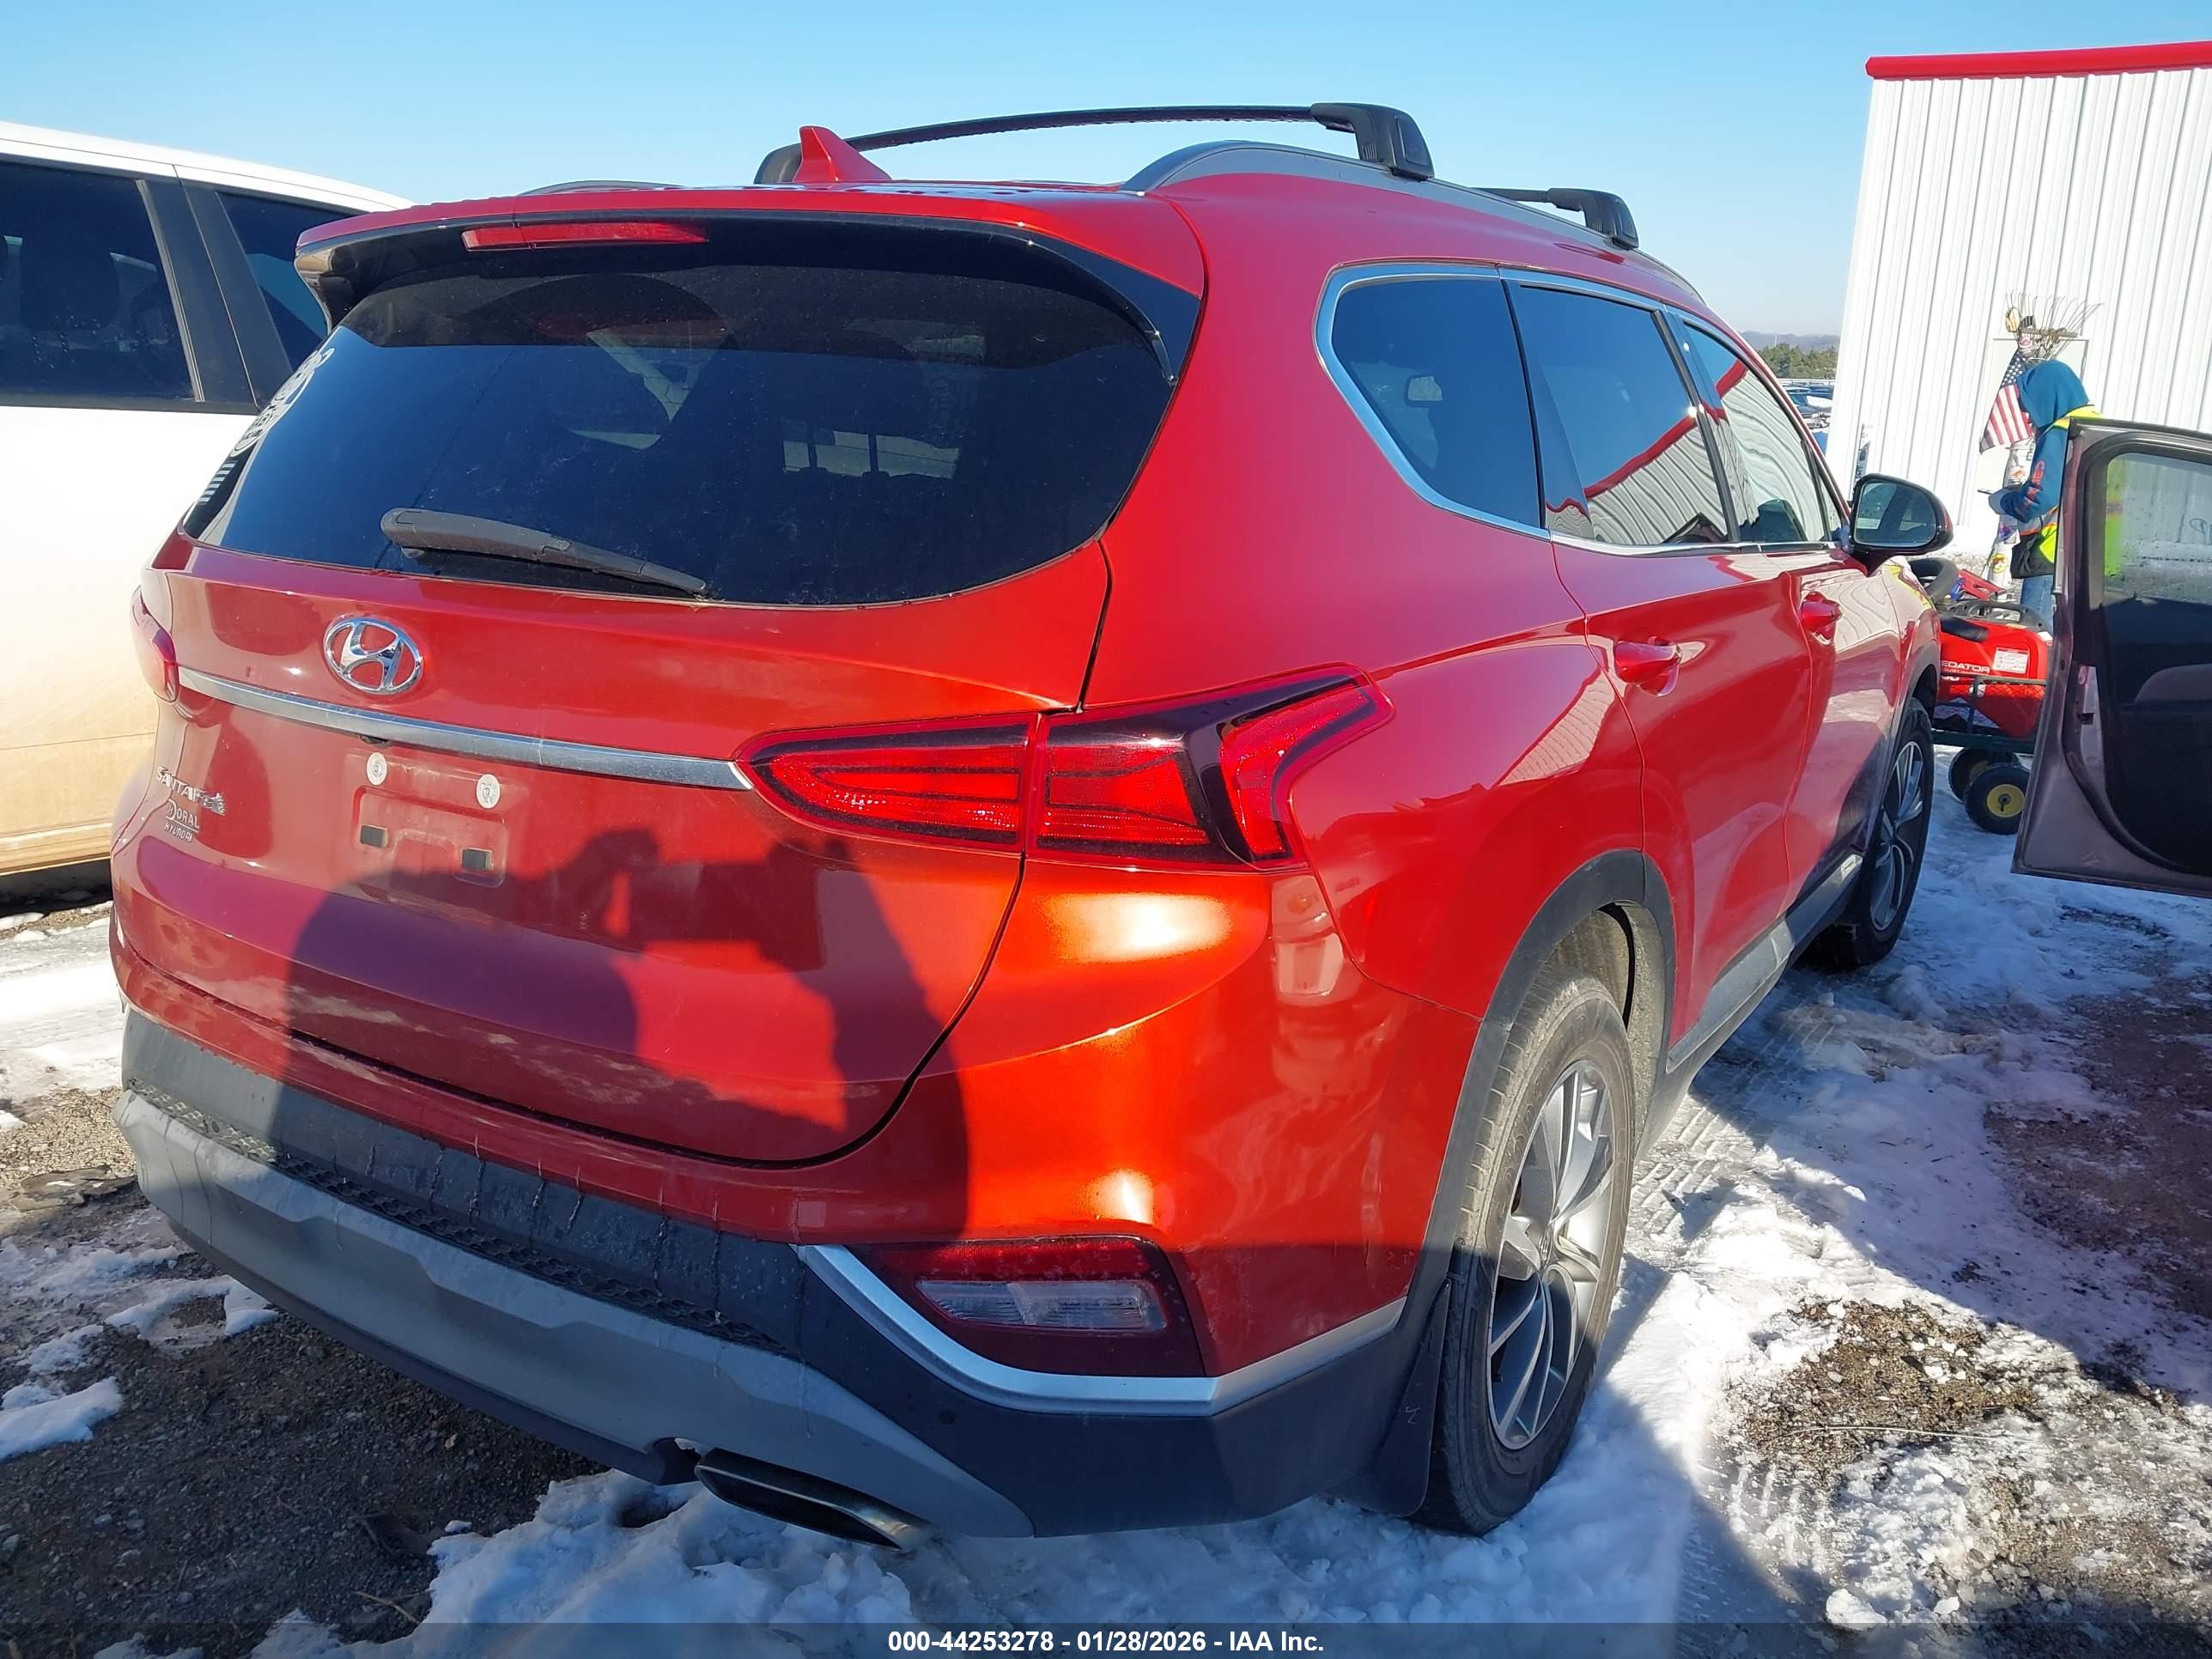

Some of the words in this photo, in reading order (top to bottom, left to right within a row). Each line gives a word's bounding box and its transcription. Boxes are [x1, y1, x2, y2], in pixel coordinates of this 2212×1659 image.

[1941, 659, 1990, 674] EDATOR
[166, 798, 200, 830] DORAL
[164, 821, 193, 842] HYUNDAI
